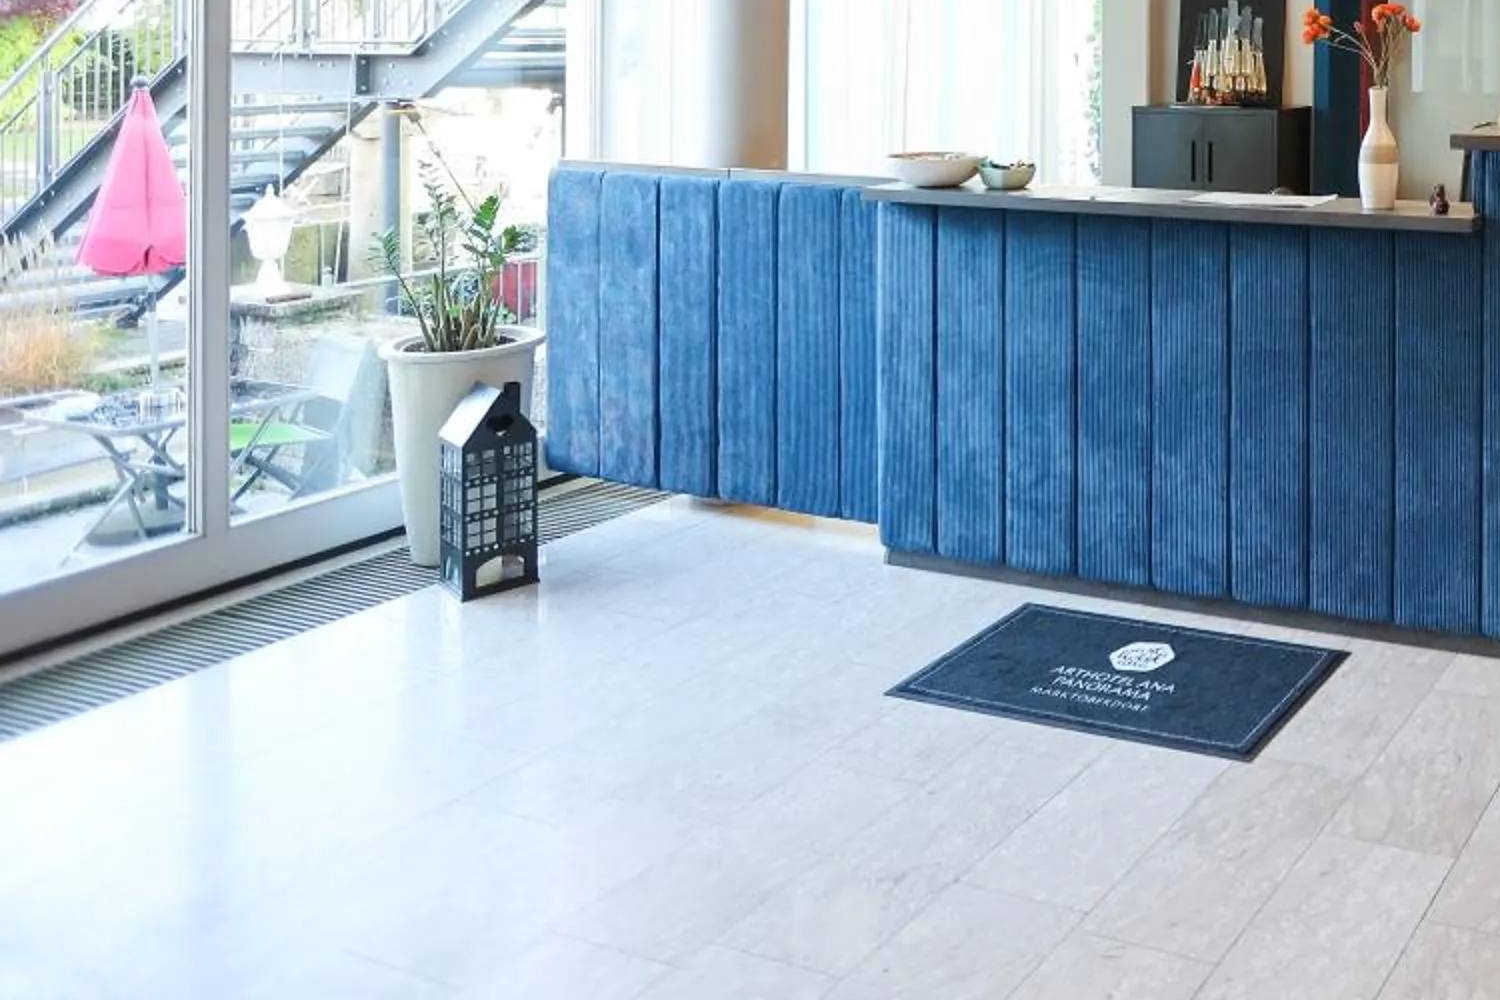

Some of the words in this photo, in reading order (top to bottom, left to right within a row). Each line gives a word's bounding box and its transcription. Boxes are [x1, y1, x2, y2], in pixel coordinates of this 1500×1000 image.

[1051, 665, 1135, 687] ARTHOTEL
[1136, 680, 1175, 694] ANA
[1052, 676, 1151, 701] PANORAMA
